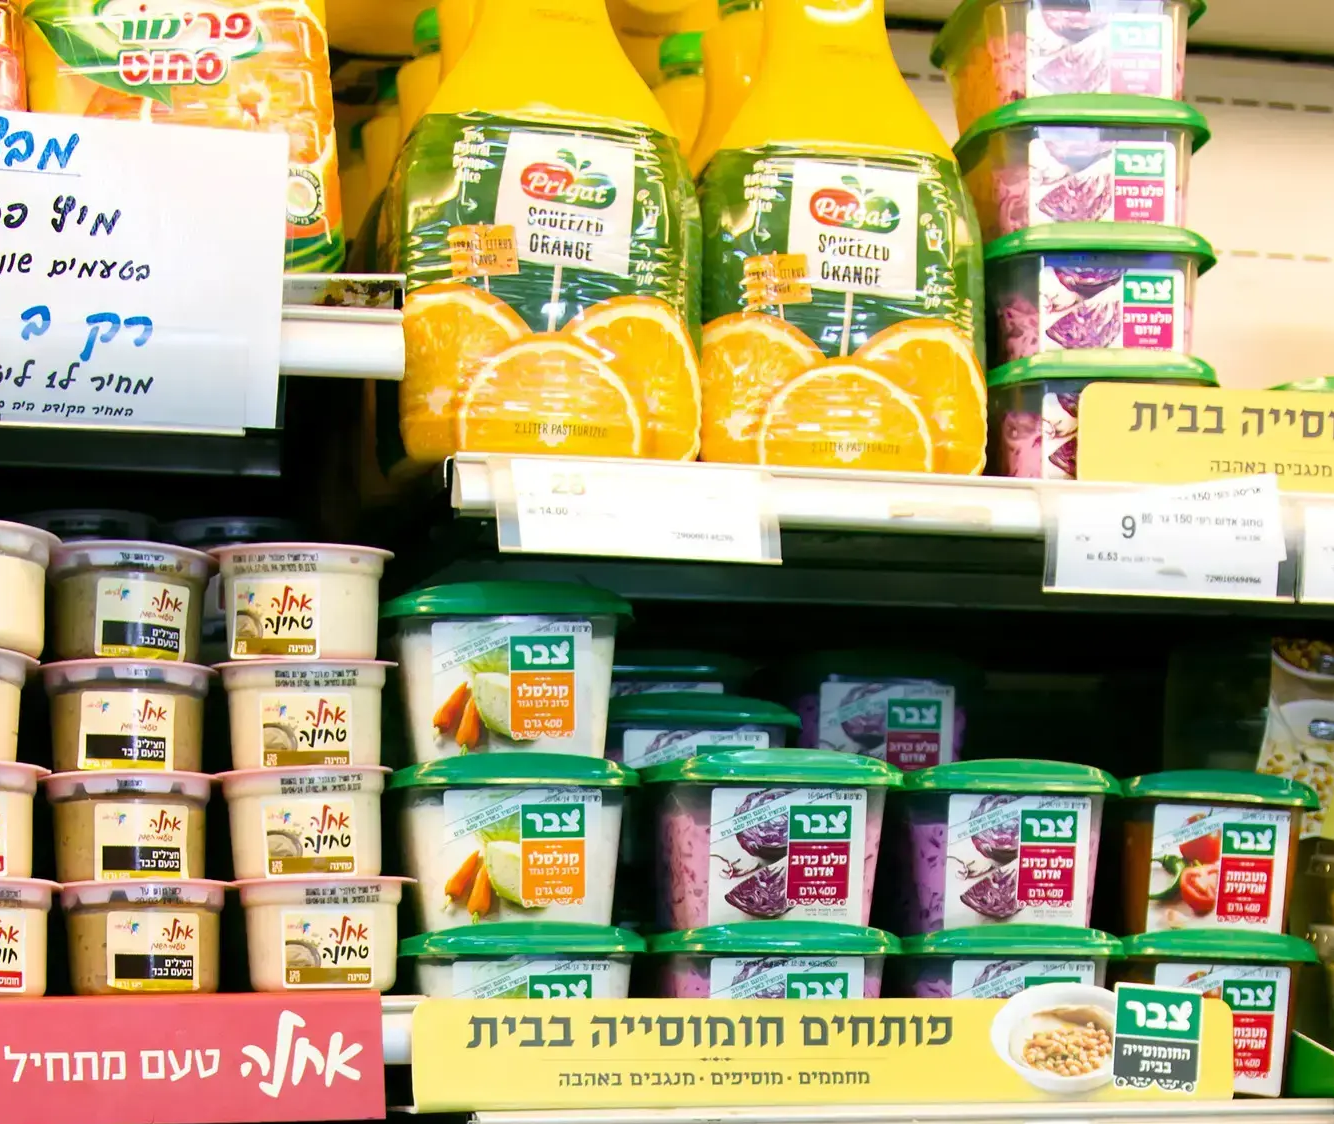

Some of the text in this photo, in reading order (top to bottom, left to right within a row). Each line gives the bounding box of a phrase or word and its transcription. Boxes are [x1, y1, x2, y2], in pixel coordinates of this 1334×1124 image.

[526, 171, 608, 204] Prigat
[51, 196, 120, 236] מיץ
[528, 207, 604, 236] SQUEEZED
[529, 233, 593, 262] ORANGE
[47, 258, 150, 281] בטעמים
[1126, 279, 1172, 299] צבר
[21, 306, 51, 340] ב
[80, 313, 153, 362] רק
[91, 374, 153, 394] מחיר
[12, 401, 35, 411] היה
[42, 403, 85, 417] הקודם
[92, 406, 133, 416] המחיר
[1130, 401, 1225, 434] בבית
[1209, 459, 1267, 476] באהבה
[1275, 463, 1332, 477] מנגבים
[1120, 513, 1137, 540] 9
[515, 640, 569, 665] צבר
[517, 684, 569, 698] קולסלו
[792, 854, 848, 865] סלט כרוב
[1223, 882, 1265, 895] אמיתית
[1226, 871, 1266, 883] מטבוחה
[323, 942, 369, 967] טחינה
[1126, 1001, 1192, 1030] צבר
[466, 1015, 952, 1048] פותחים חומוסייה בבית
[4, 1046, 125, 1082] מתחיל
[241, 1010, 363, 1097] אחלה
[1123, 1044, 1190, 1060] החומוסייה
[140, 1049, 220, 1081] טעם
[1140, 1060, 1171, 1073] בבית
[559, 1072, 869, 1086] מחממים מוסיפים מנגבים באהבה
